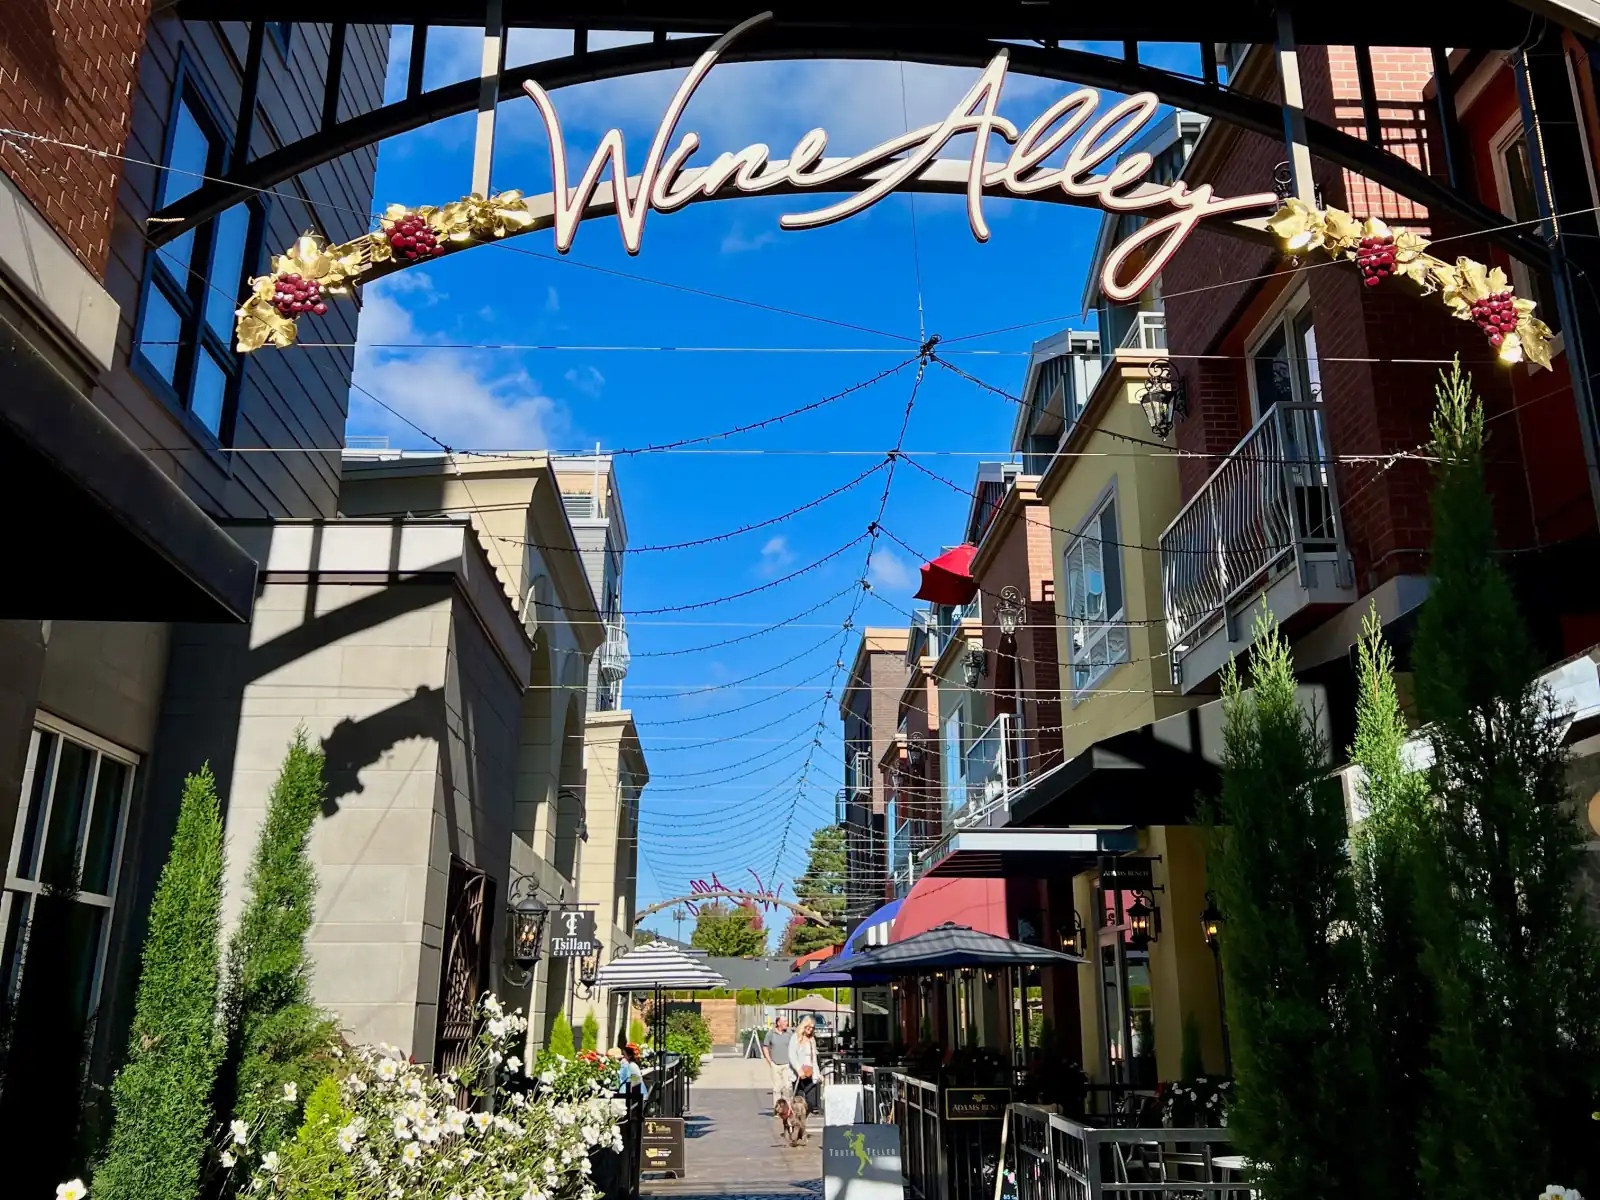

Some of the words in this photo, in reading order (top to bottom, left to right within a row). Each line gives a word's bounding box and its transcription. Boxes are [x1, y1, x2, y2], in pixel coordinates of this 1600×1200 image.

[522, 11, 834, 255] Wine
[780, 49, 1278, 302] Alley
[551, 937, 592, 951] Tsillan
[953, 1103, 980, 1111] ADAMS
